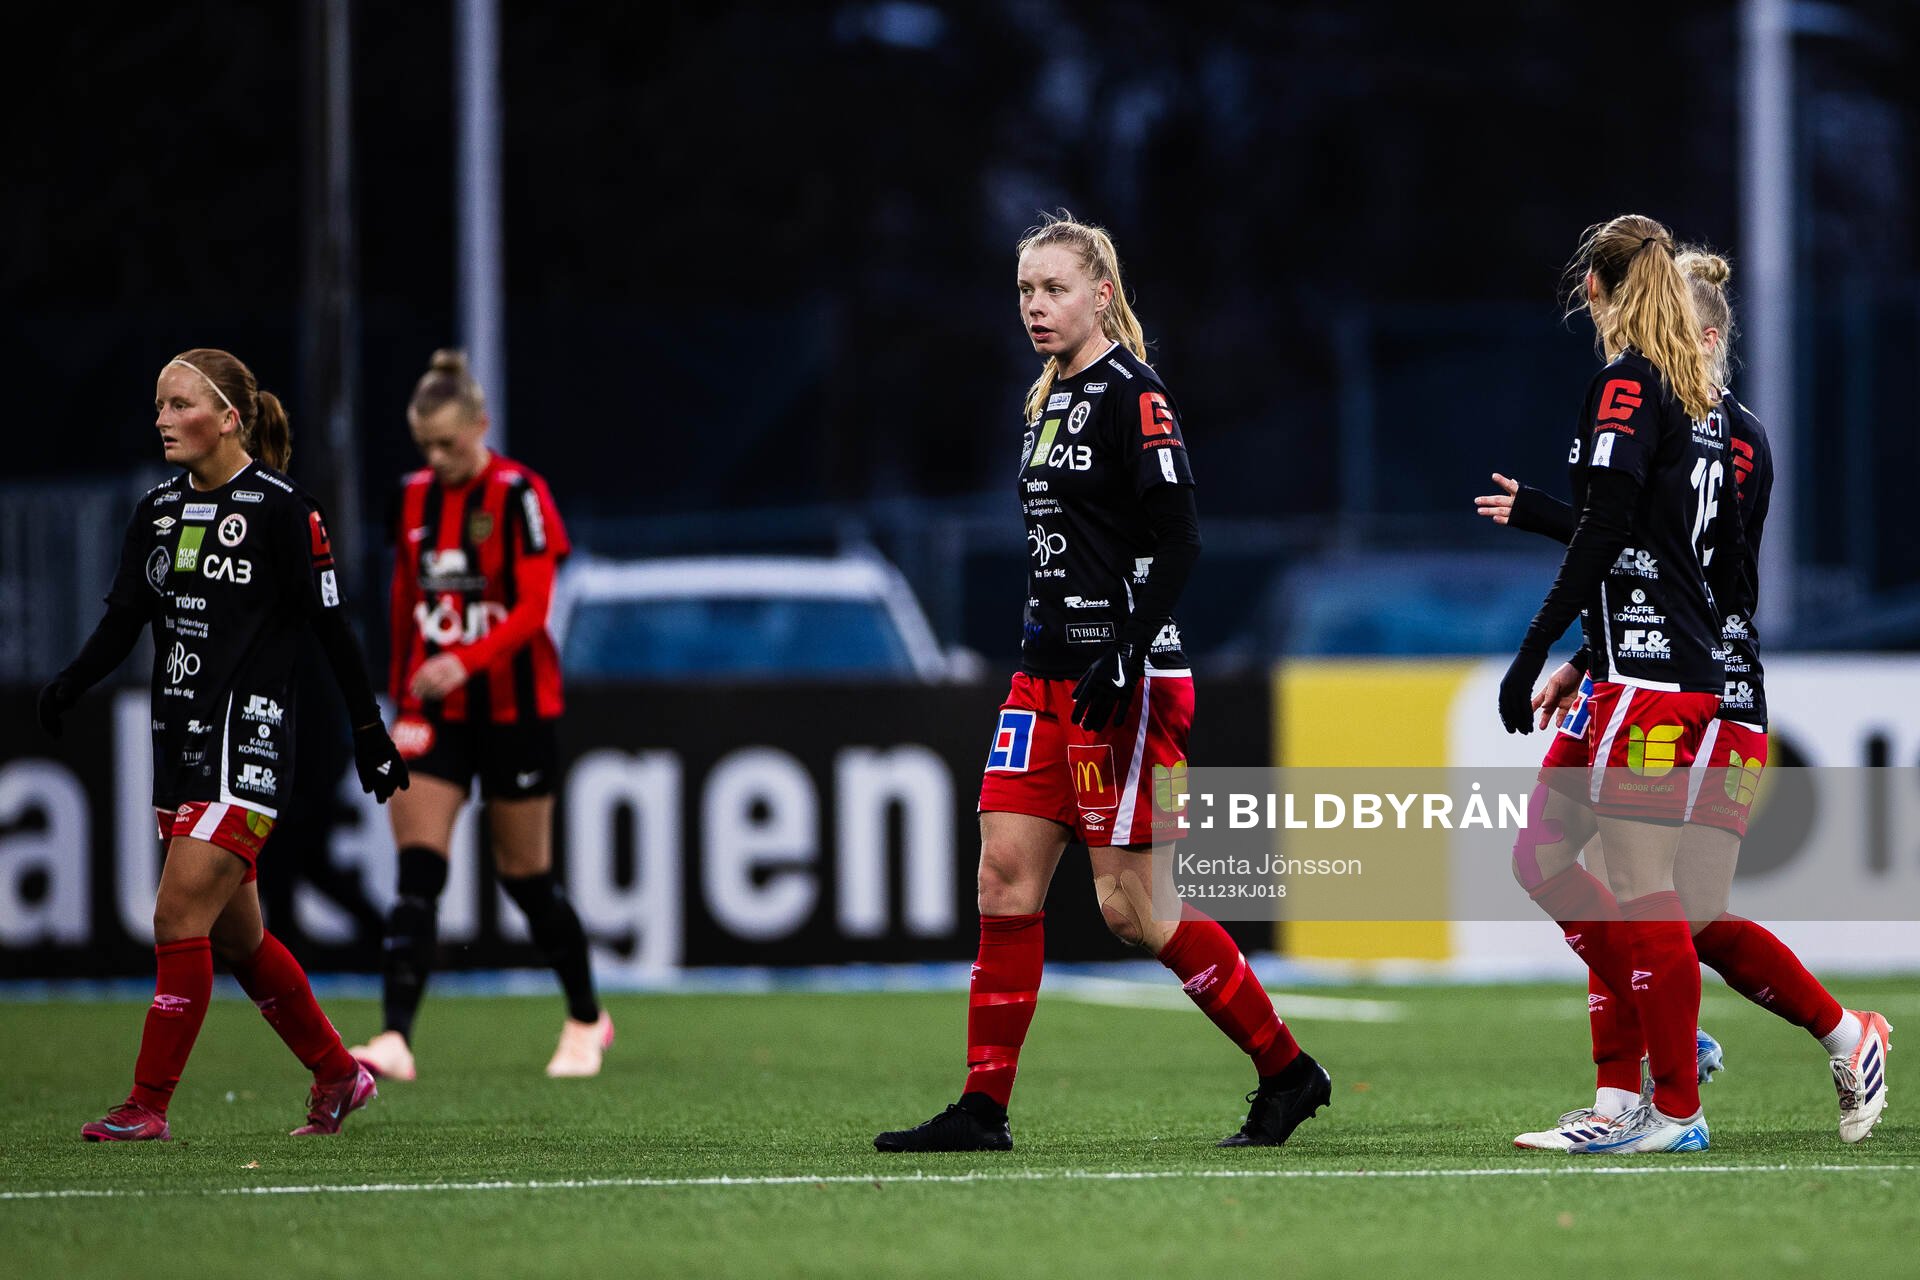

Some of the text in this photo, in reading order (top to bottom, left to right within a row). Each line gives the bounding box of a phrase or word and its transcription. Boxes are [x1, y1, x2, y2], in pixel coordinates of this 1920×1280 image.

[1048, 444, 1092, 471] CAB
[177, 558, 196, 569] BRO
[203, 554, 252, 584] CAB
[1623, 606, 1655, 614] KAFFE
[1613, 613, 1666, 624] KOMPANIET
[1070, 627, 1110, 638] TYBBLE
[1619, 630, 1671, 653] JE&
[1618, 651, 1671, 660] FASTIGHETER
[243, 694, 284, 720] JE&
[249, 737, 274, 751] KAFFE
[237, 763, 277, 790] JE&
